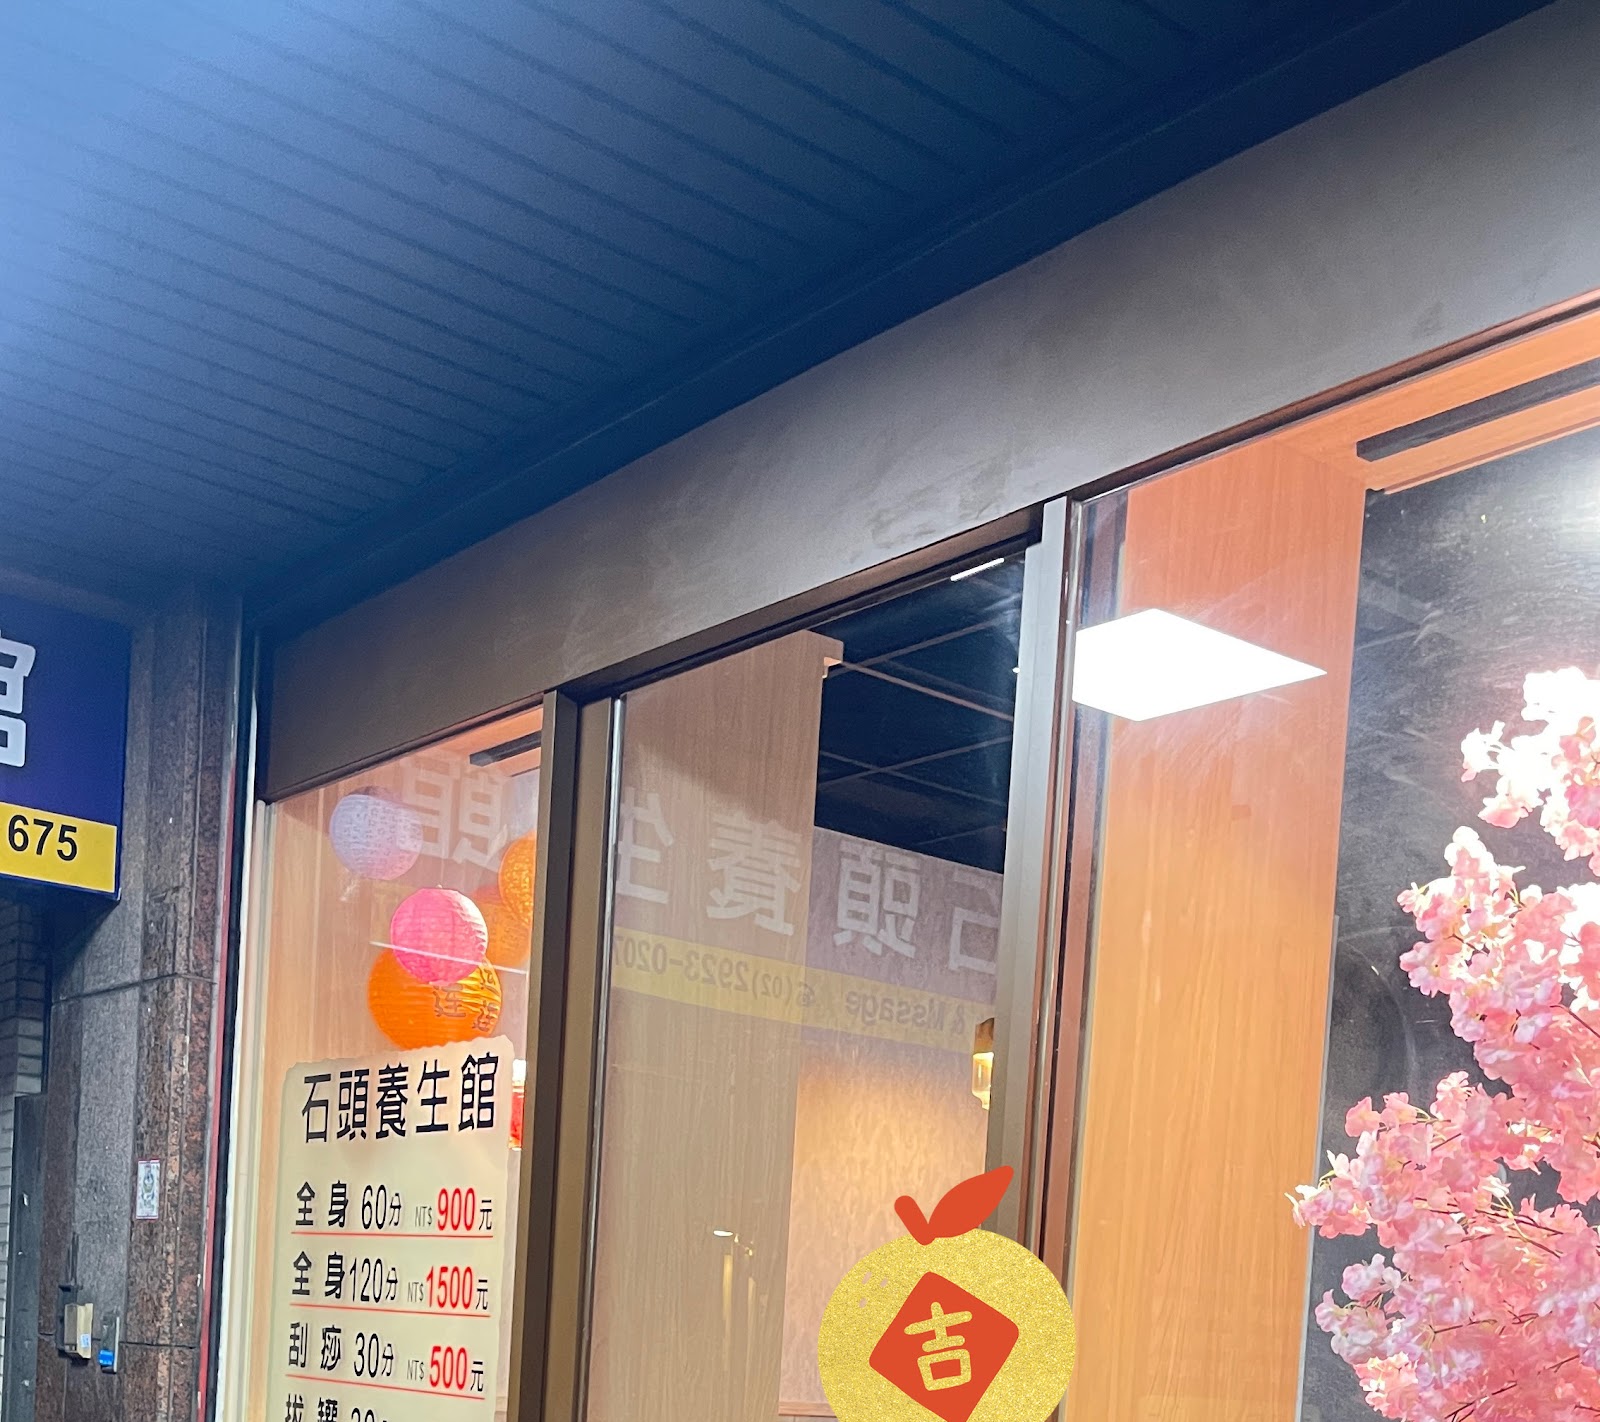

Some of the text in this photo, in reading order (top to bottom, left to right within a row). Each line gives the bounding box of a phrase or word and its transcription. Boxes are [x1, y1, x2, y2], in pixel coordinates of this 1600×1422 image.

[8, 814, 78, 862] 675
[302, 1052, 499, 1143] 石頭養生館
